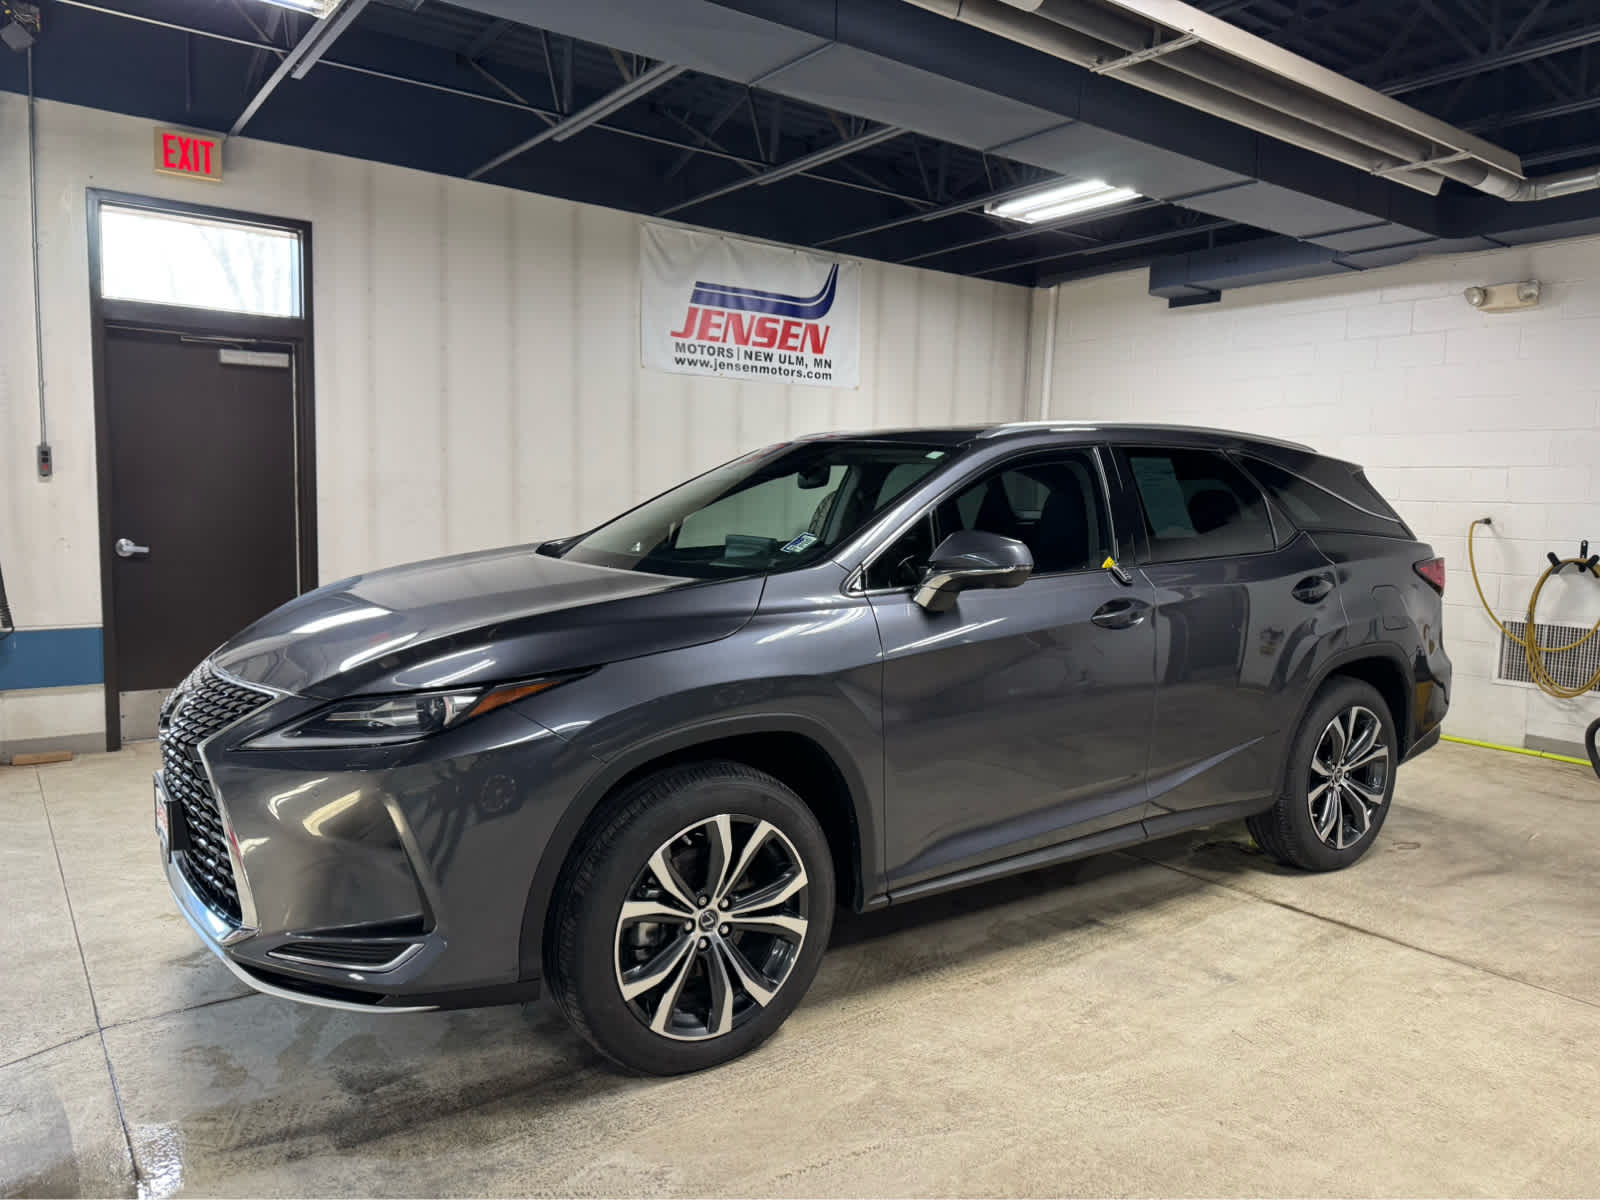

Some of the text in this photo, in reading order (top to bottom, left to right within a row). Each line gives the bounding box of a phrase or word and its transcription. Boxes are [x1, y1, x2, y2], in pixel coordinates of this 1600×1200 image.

[162, 133, 216, 175] EXIT
[670, 306, 831, 355] JENSEN
[674, 341, 832, 369] MOTORS NEW ULM, MN
[674, 356, 832, 381] www.jensenmotors.com
